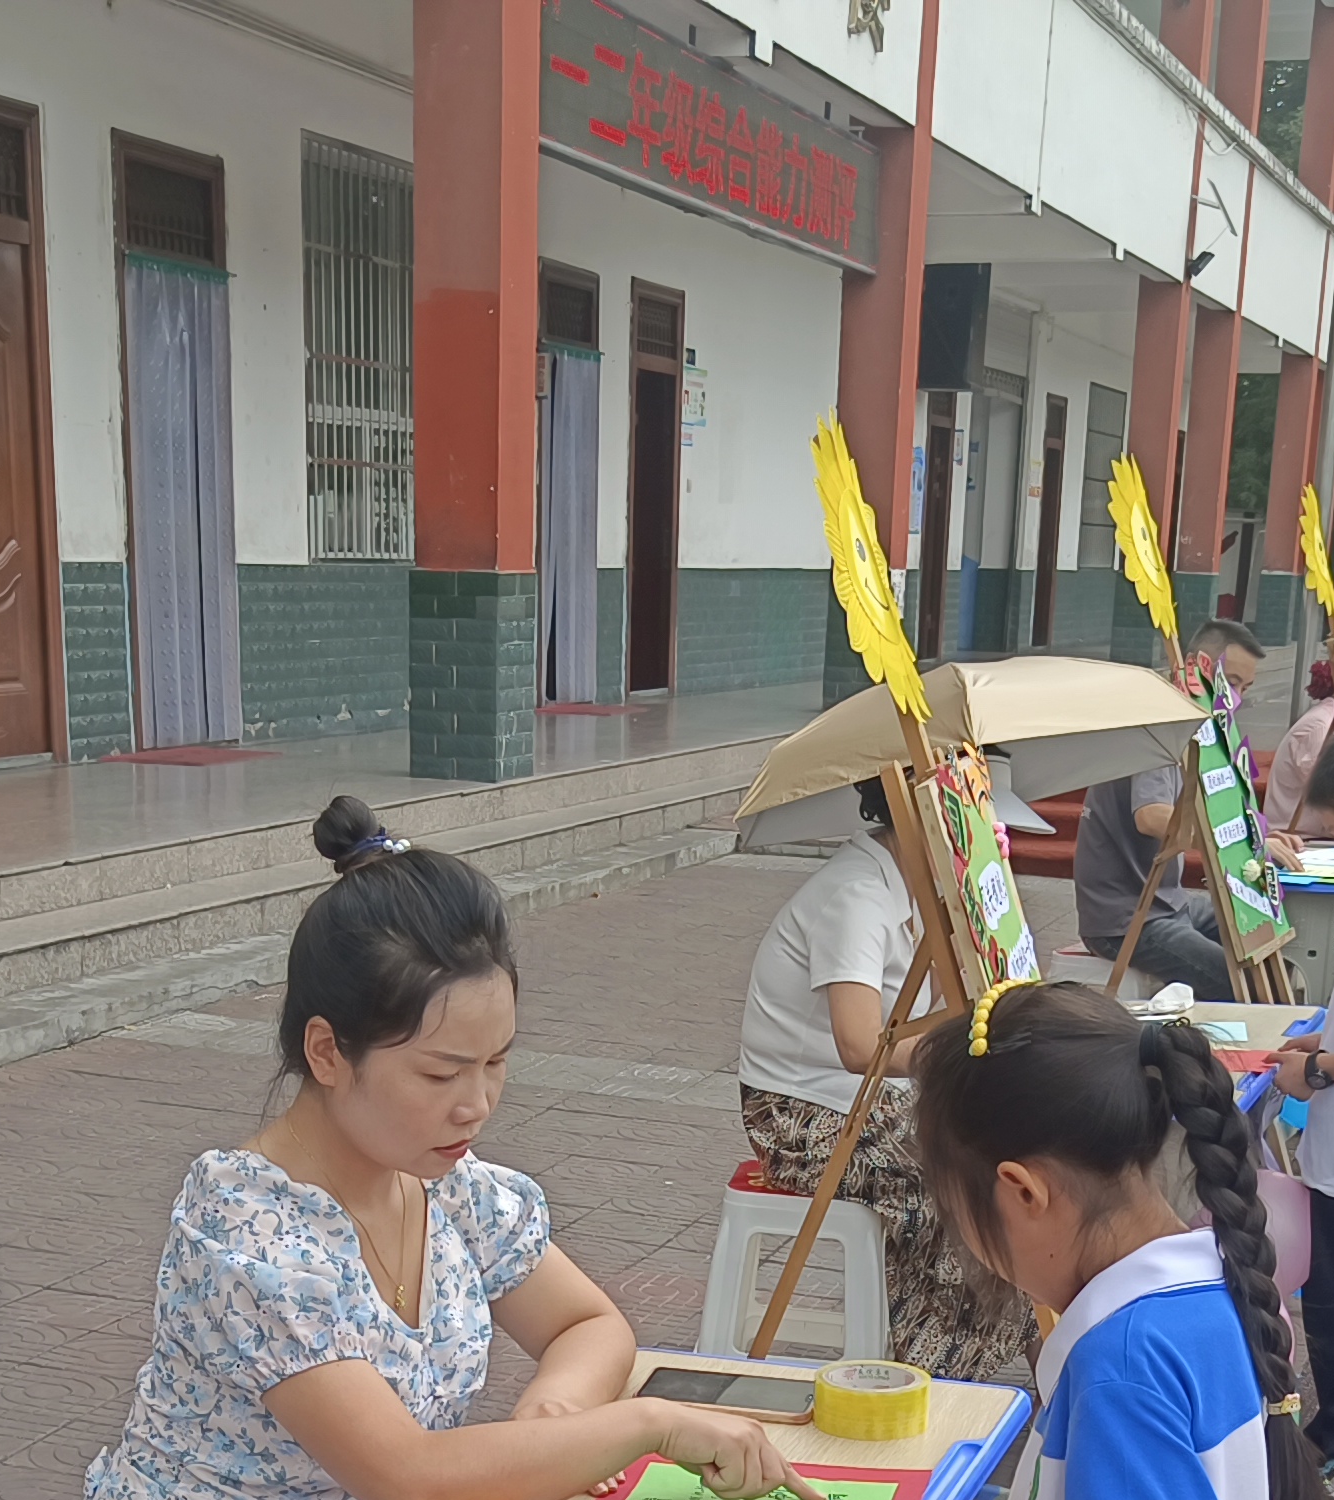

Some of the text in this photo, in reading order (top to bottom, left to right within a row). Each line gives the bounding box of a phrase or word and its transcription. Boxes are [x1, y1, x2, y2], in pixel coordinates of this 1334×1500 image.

[550, 44, 859, 250] 一二年级综合能力测评
